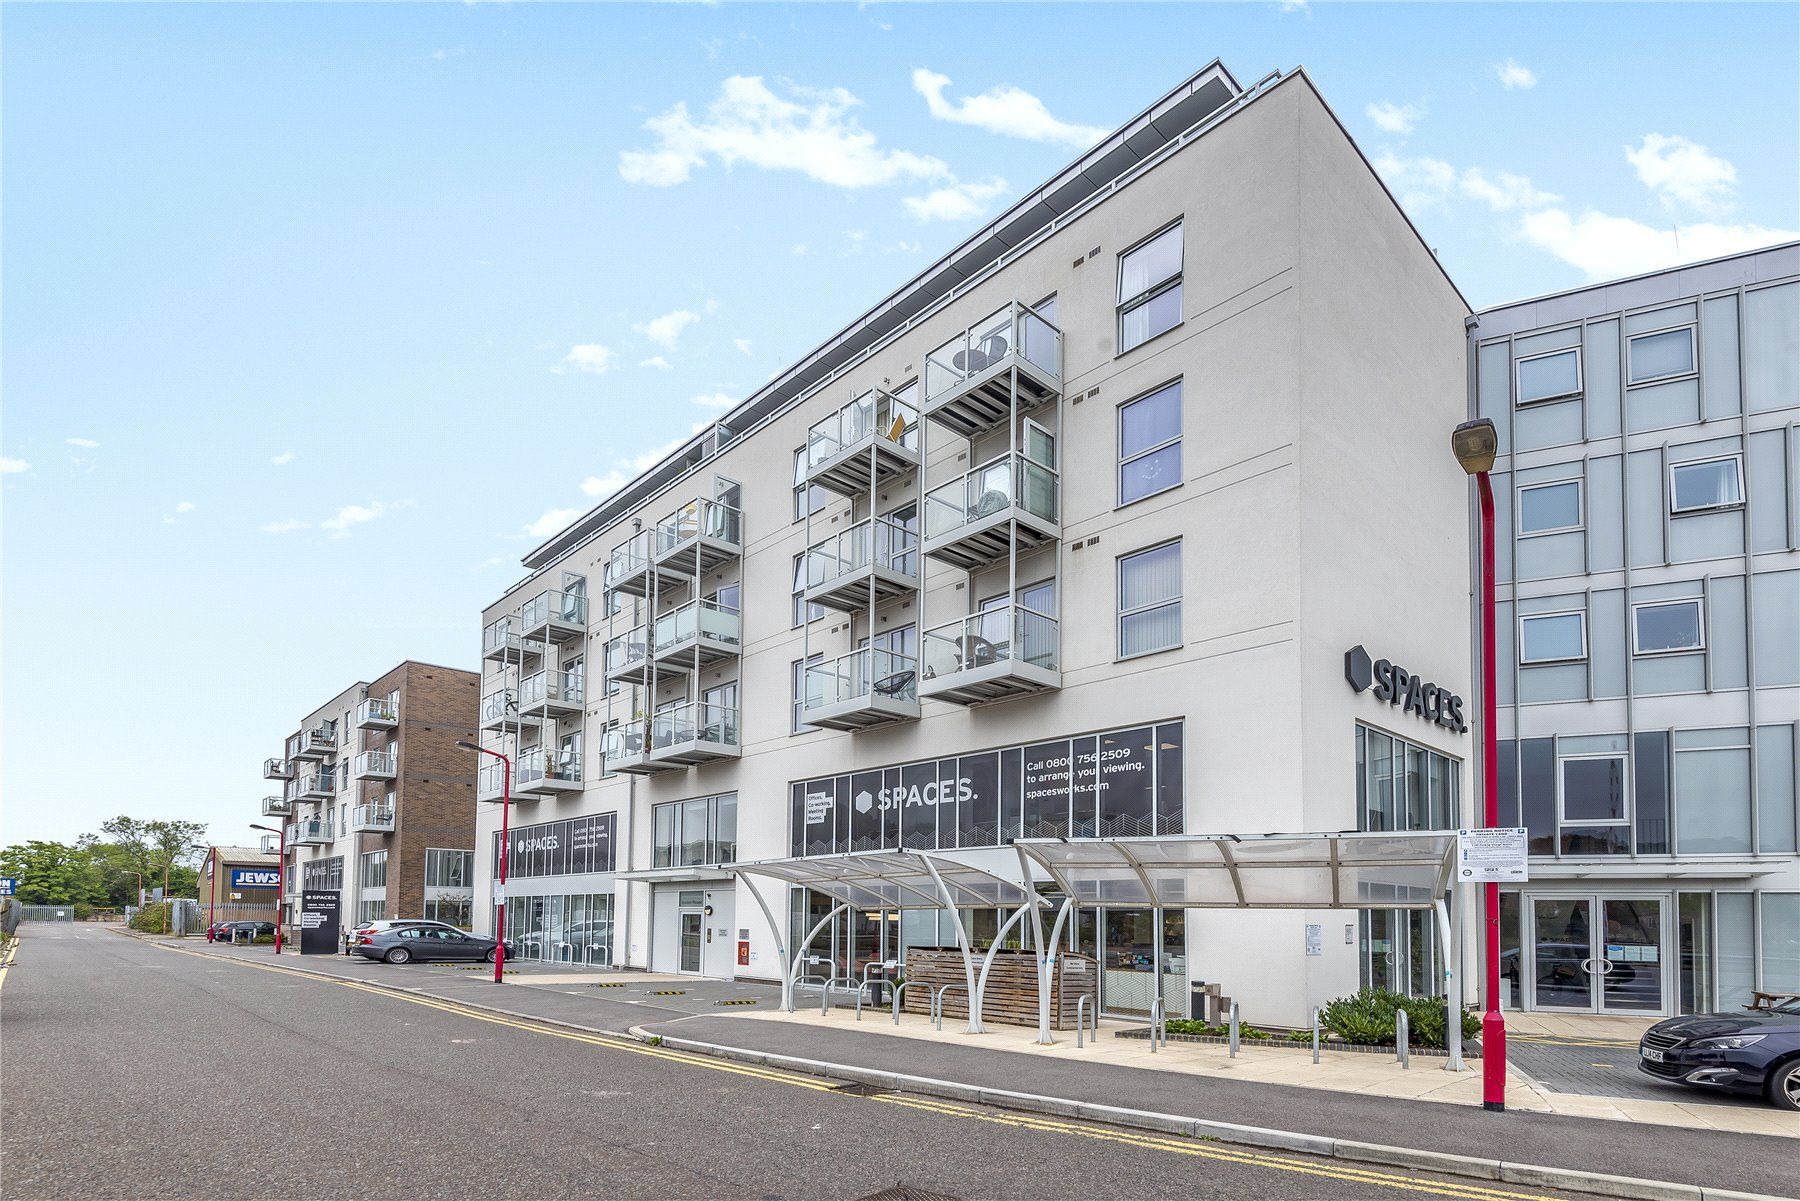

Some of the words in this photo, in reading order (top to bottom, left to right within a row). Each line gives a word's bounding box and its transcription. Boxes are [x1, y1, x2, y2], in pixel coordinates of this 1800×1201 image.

[1372, 658, 1468, 734] SPACES.
[1027, 761, 1044, 771] Call
[1077, 753, 1097, 764] 756
[1101, 748, 1131, 761] 2509
[1026, 775, 1036, 783] to
[1078, 768, 1098, 779] you
[1103, 762, 1145, 774] viewing.
[877, 777, 978, 811] SPACES.
[1026, 782, 1109, 800] spaceswoks.com
[525, 835, 560, 852] SPACES.
[0, 879, 11, 887] N
[236, 872, 280, 884] JEWS
